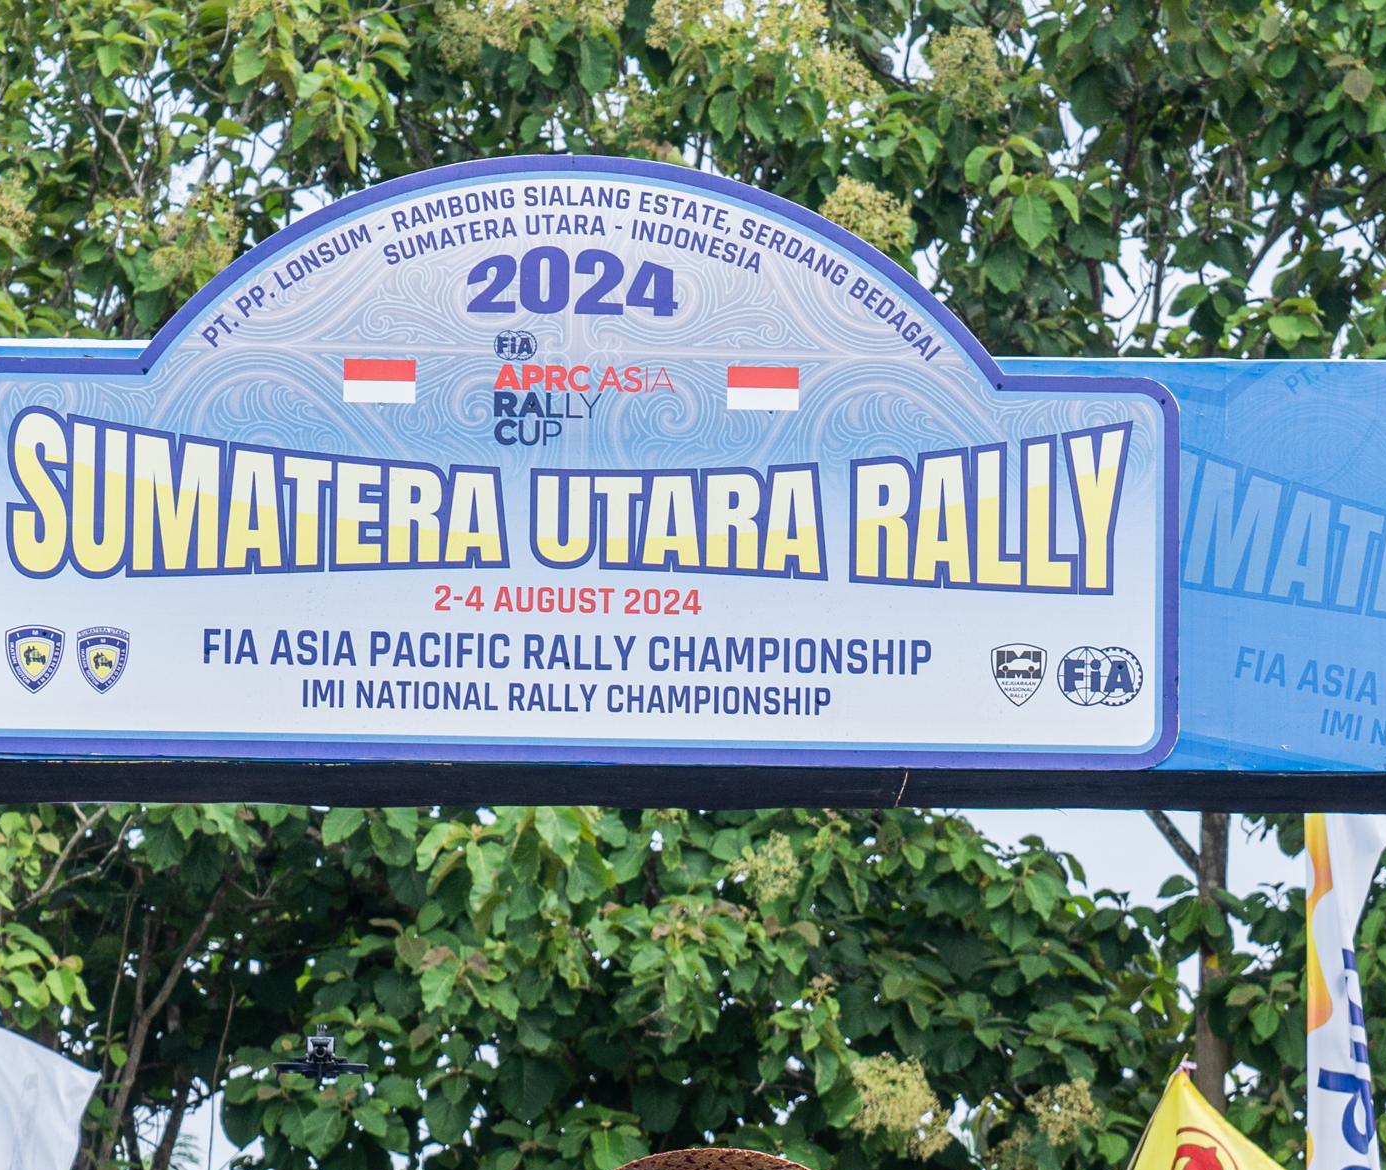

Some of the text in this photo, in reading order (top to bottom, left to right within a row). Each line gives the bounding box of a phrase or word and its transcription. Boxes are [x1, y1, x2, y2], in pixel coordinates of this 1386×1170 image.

[382, 213, 763, 274] SUMATERA UTARA INDONESIA
[201, 185, 943, 362] PT. PP. LONSUM RAMBONG SIALANG ESTATE, SERDANG BEDAGAI
[466, 245, 679, 317] 2024
[493, 363, 676, 393] APRC ASIA
[493, 391, 602, 419] RALLY
[493, 418, 563, 446] CUP
[8, 406, 1133, 597] SUMATERA UTARA RALLY
[434, 584, 703, 616] 2-4 AUGUST 2024
[202, 627, 933, 676] FIA ASIA PACIFIC RALLY CHAMPIONSHIP
[301, 678, 832, 717] IMI NATIONAL RALLY CHAMPIONSHIP
[1234, 645, 1287, 689] FIA
[1296, 659, 1379, 706] ASIA
[1320, 709, 1364, 742] IMI
